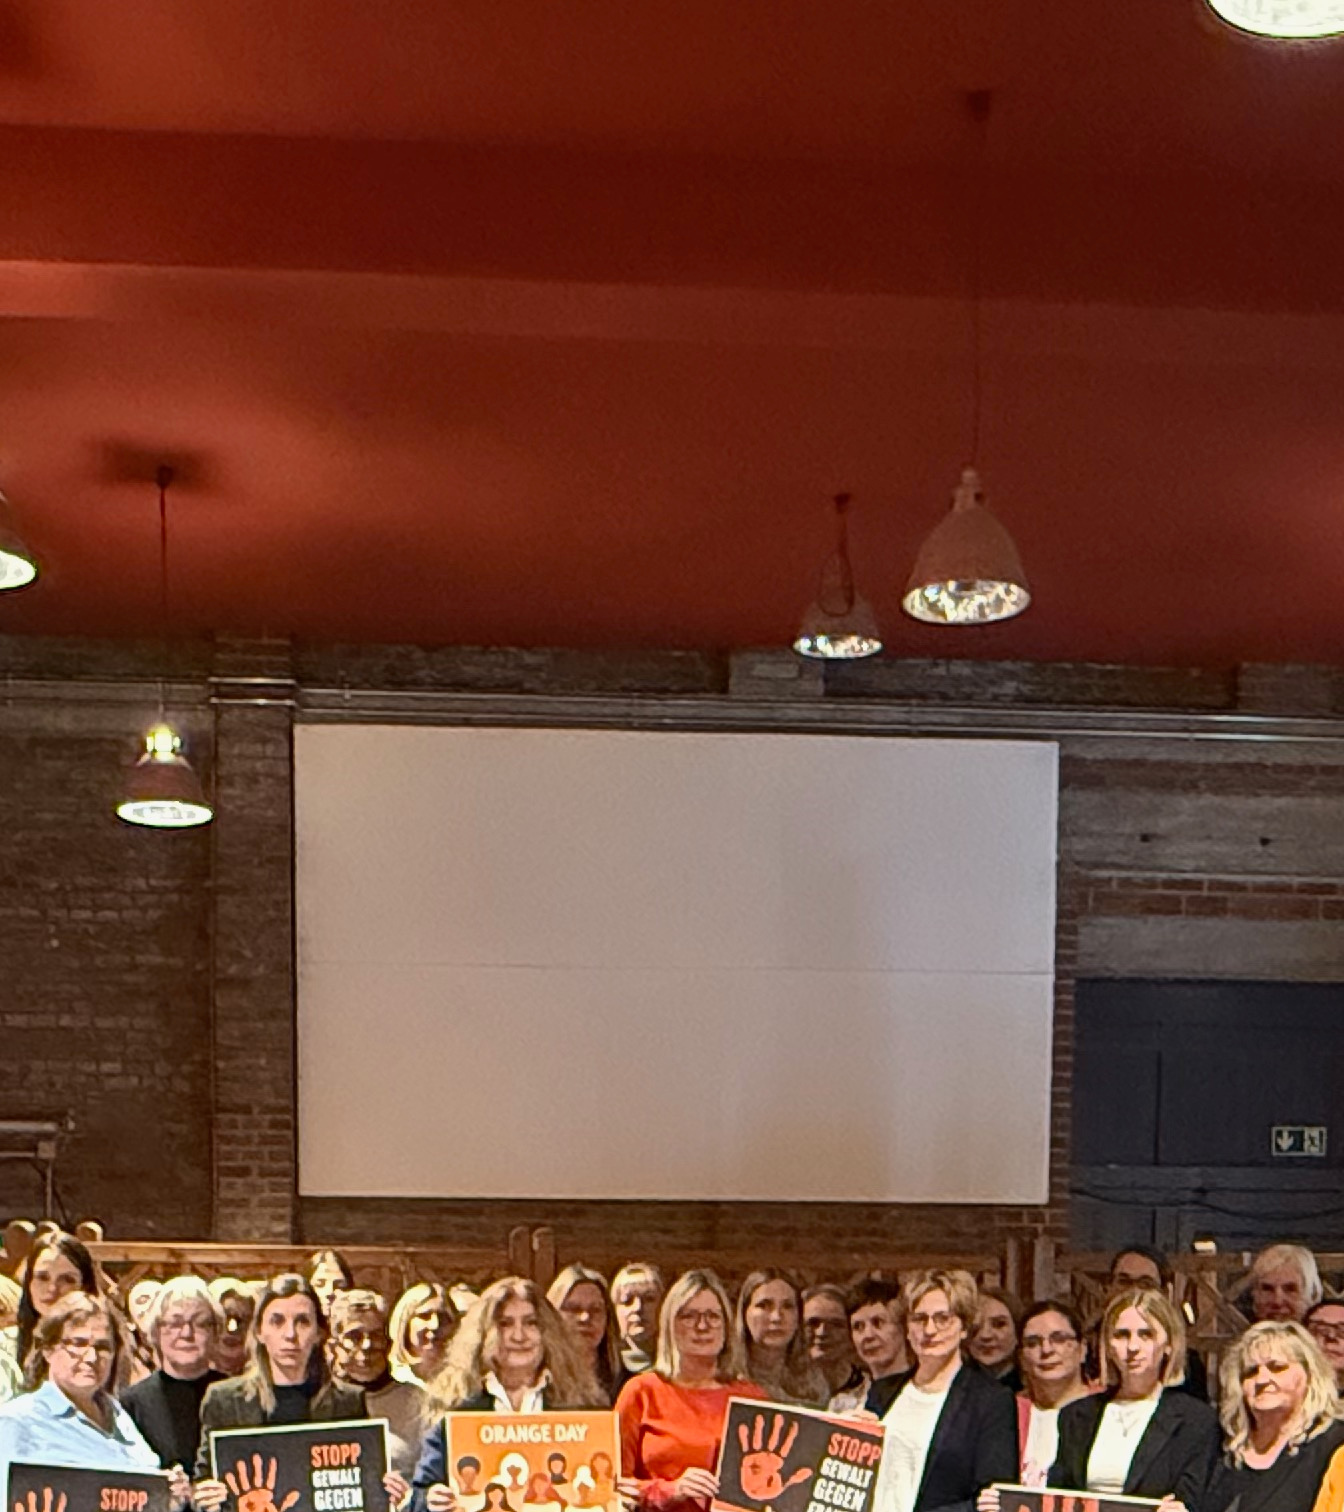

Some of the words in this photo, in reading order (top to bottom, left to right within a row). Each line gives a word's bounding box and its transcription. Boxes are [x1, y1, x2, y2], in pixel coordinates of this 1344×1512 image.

[479, 1423, 552, 1444] ORANGE
[554, 1423, 589, 1442] DAY
[311, 1442, 362, 1467] STOPP
[827, 1432, 882, 1467] STOPP
[312, 1467, 361, 1488] GEWALT
[820, 1456, 873, 1488] GEWALT
[100, 1487, 148, 1512] STOPP
[314, 1487, 364, 1511] GEGEN
[812, 1478, 866, 1512] GEGEN
